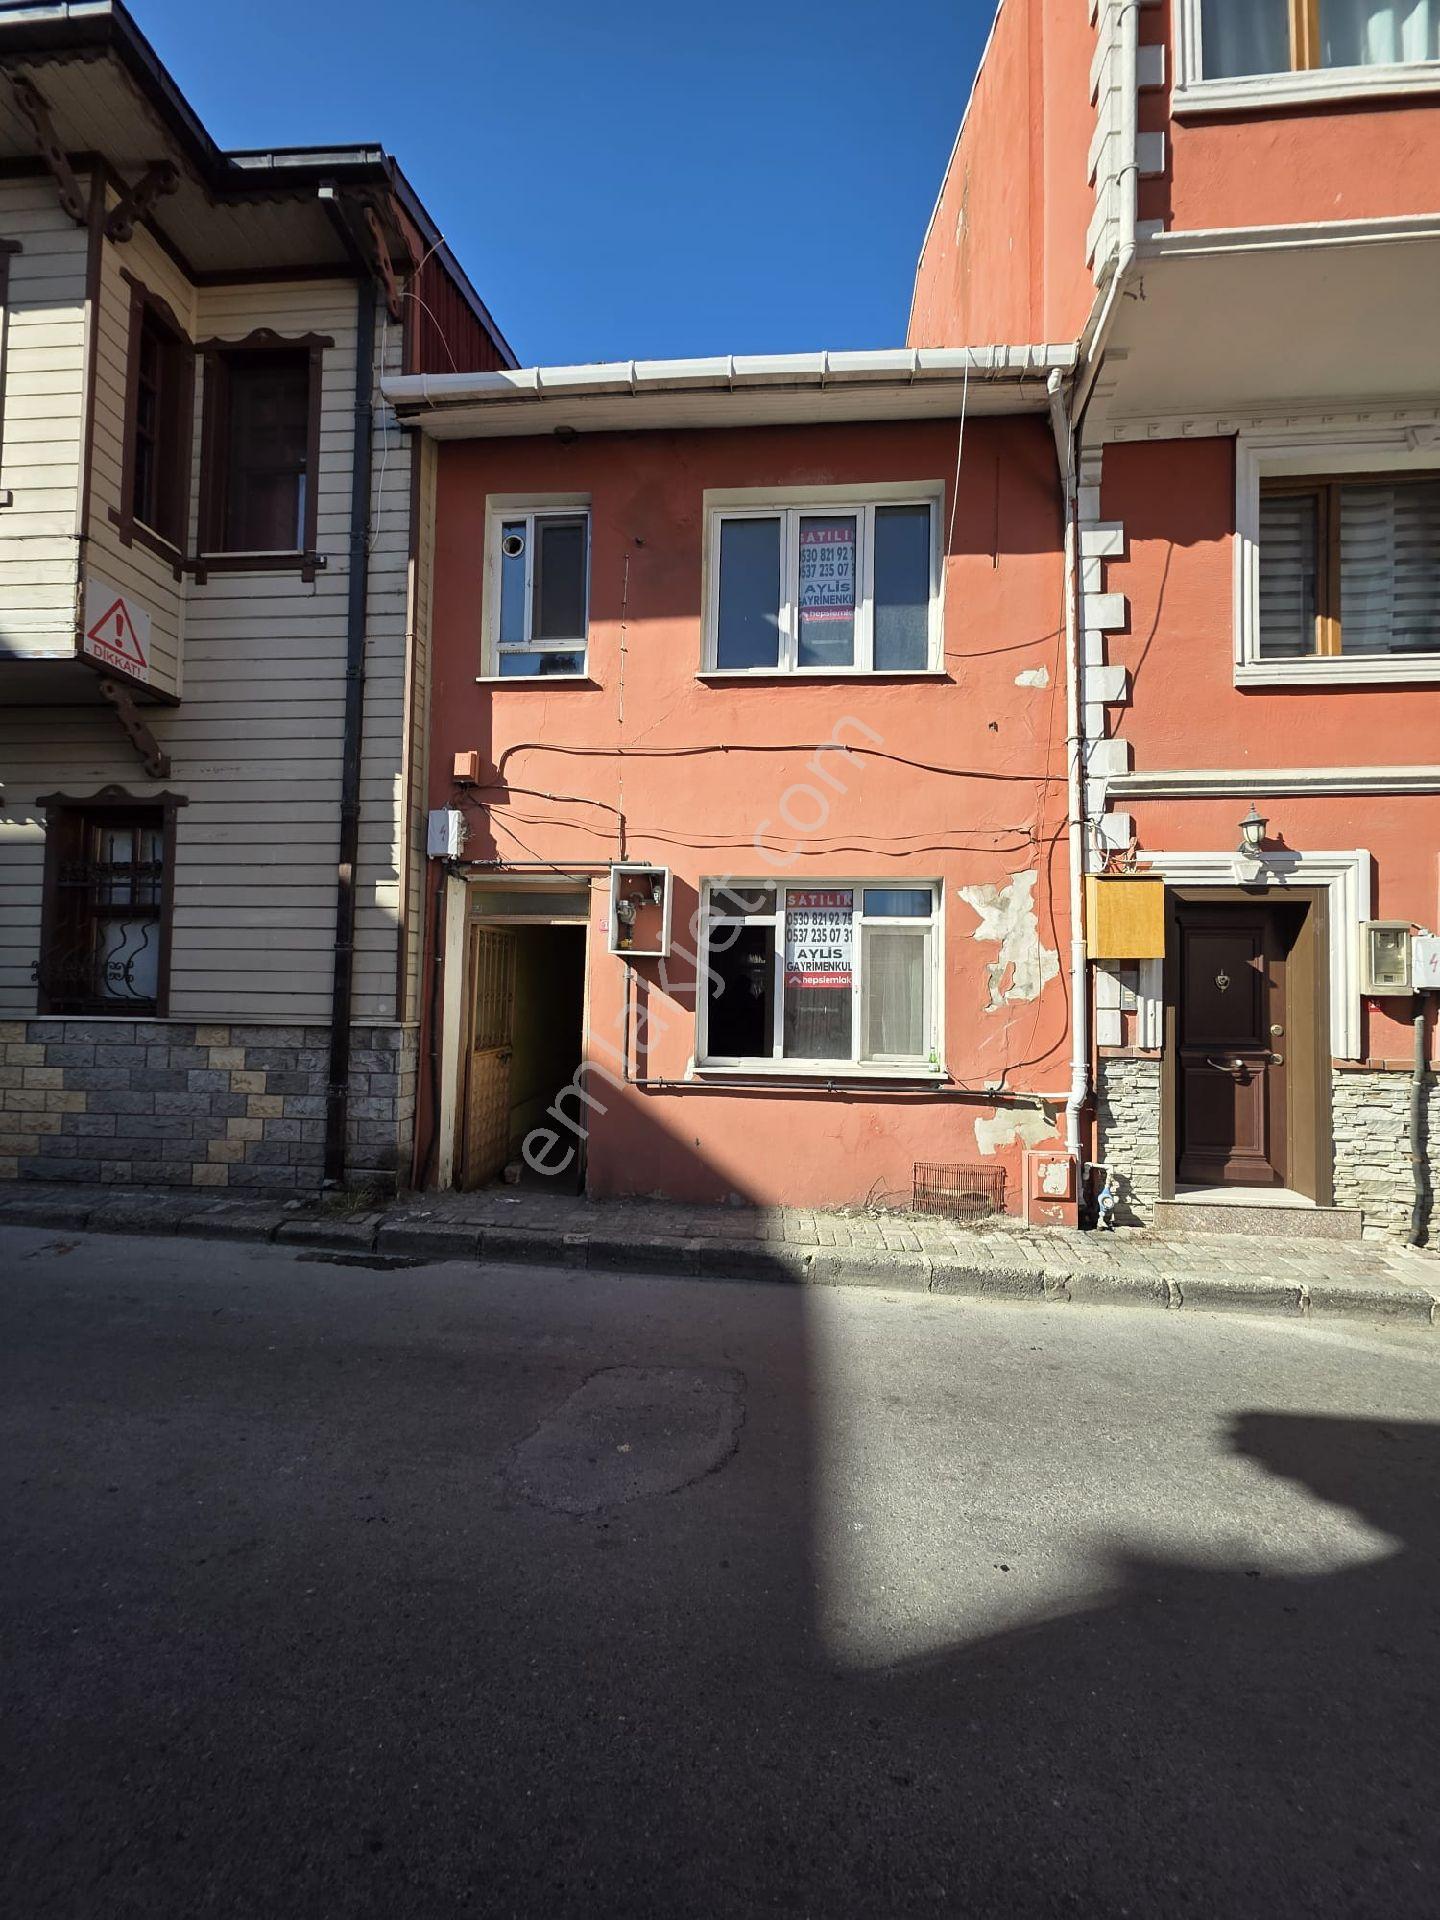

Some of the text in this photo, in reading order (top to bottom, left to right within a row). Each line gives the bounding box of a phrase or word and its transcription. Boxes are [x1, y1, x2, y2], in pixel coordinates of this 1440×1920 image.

[820, 548, 834, 562] 821
[837, 547, 848, 561] 92
[837, 563, 849, 576] 07
[787, 894, 852, 905] SATILIK
[786, 912, 809, 925] 0530
[812, 912, 827, 925] 821
[829, 912, 840, 925] 92
[786, 928, 853, 942] 0537 235 07 31
